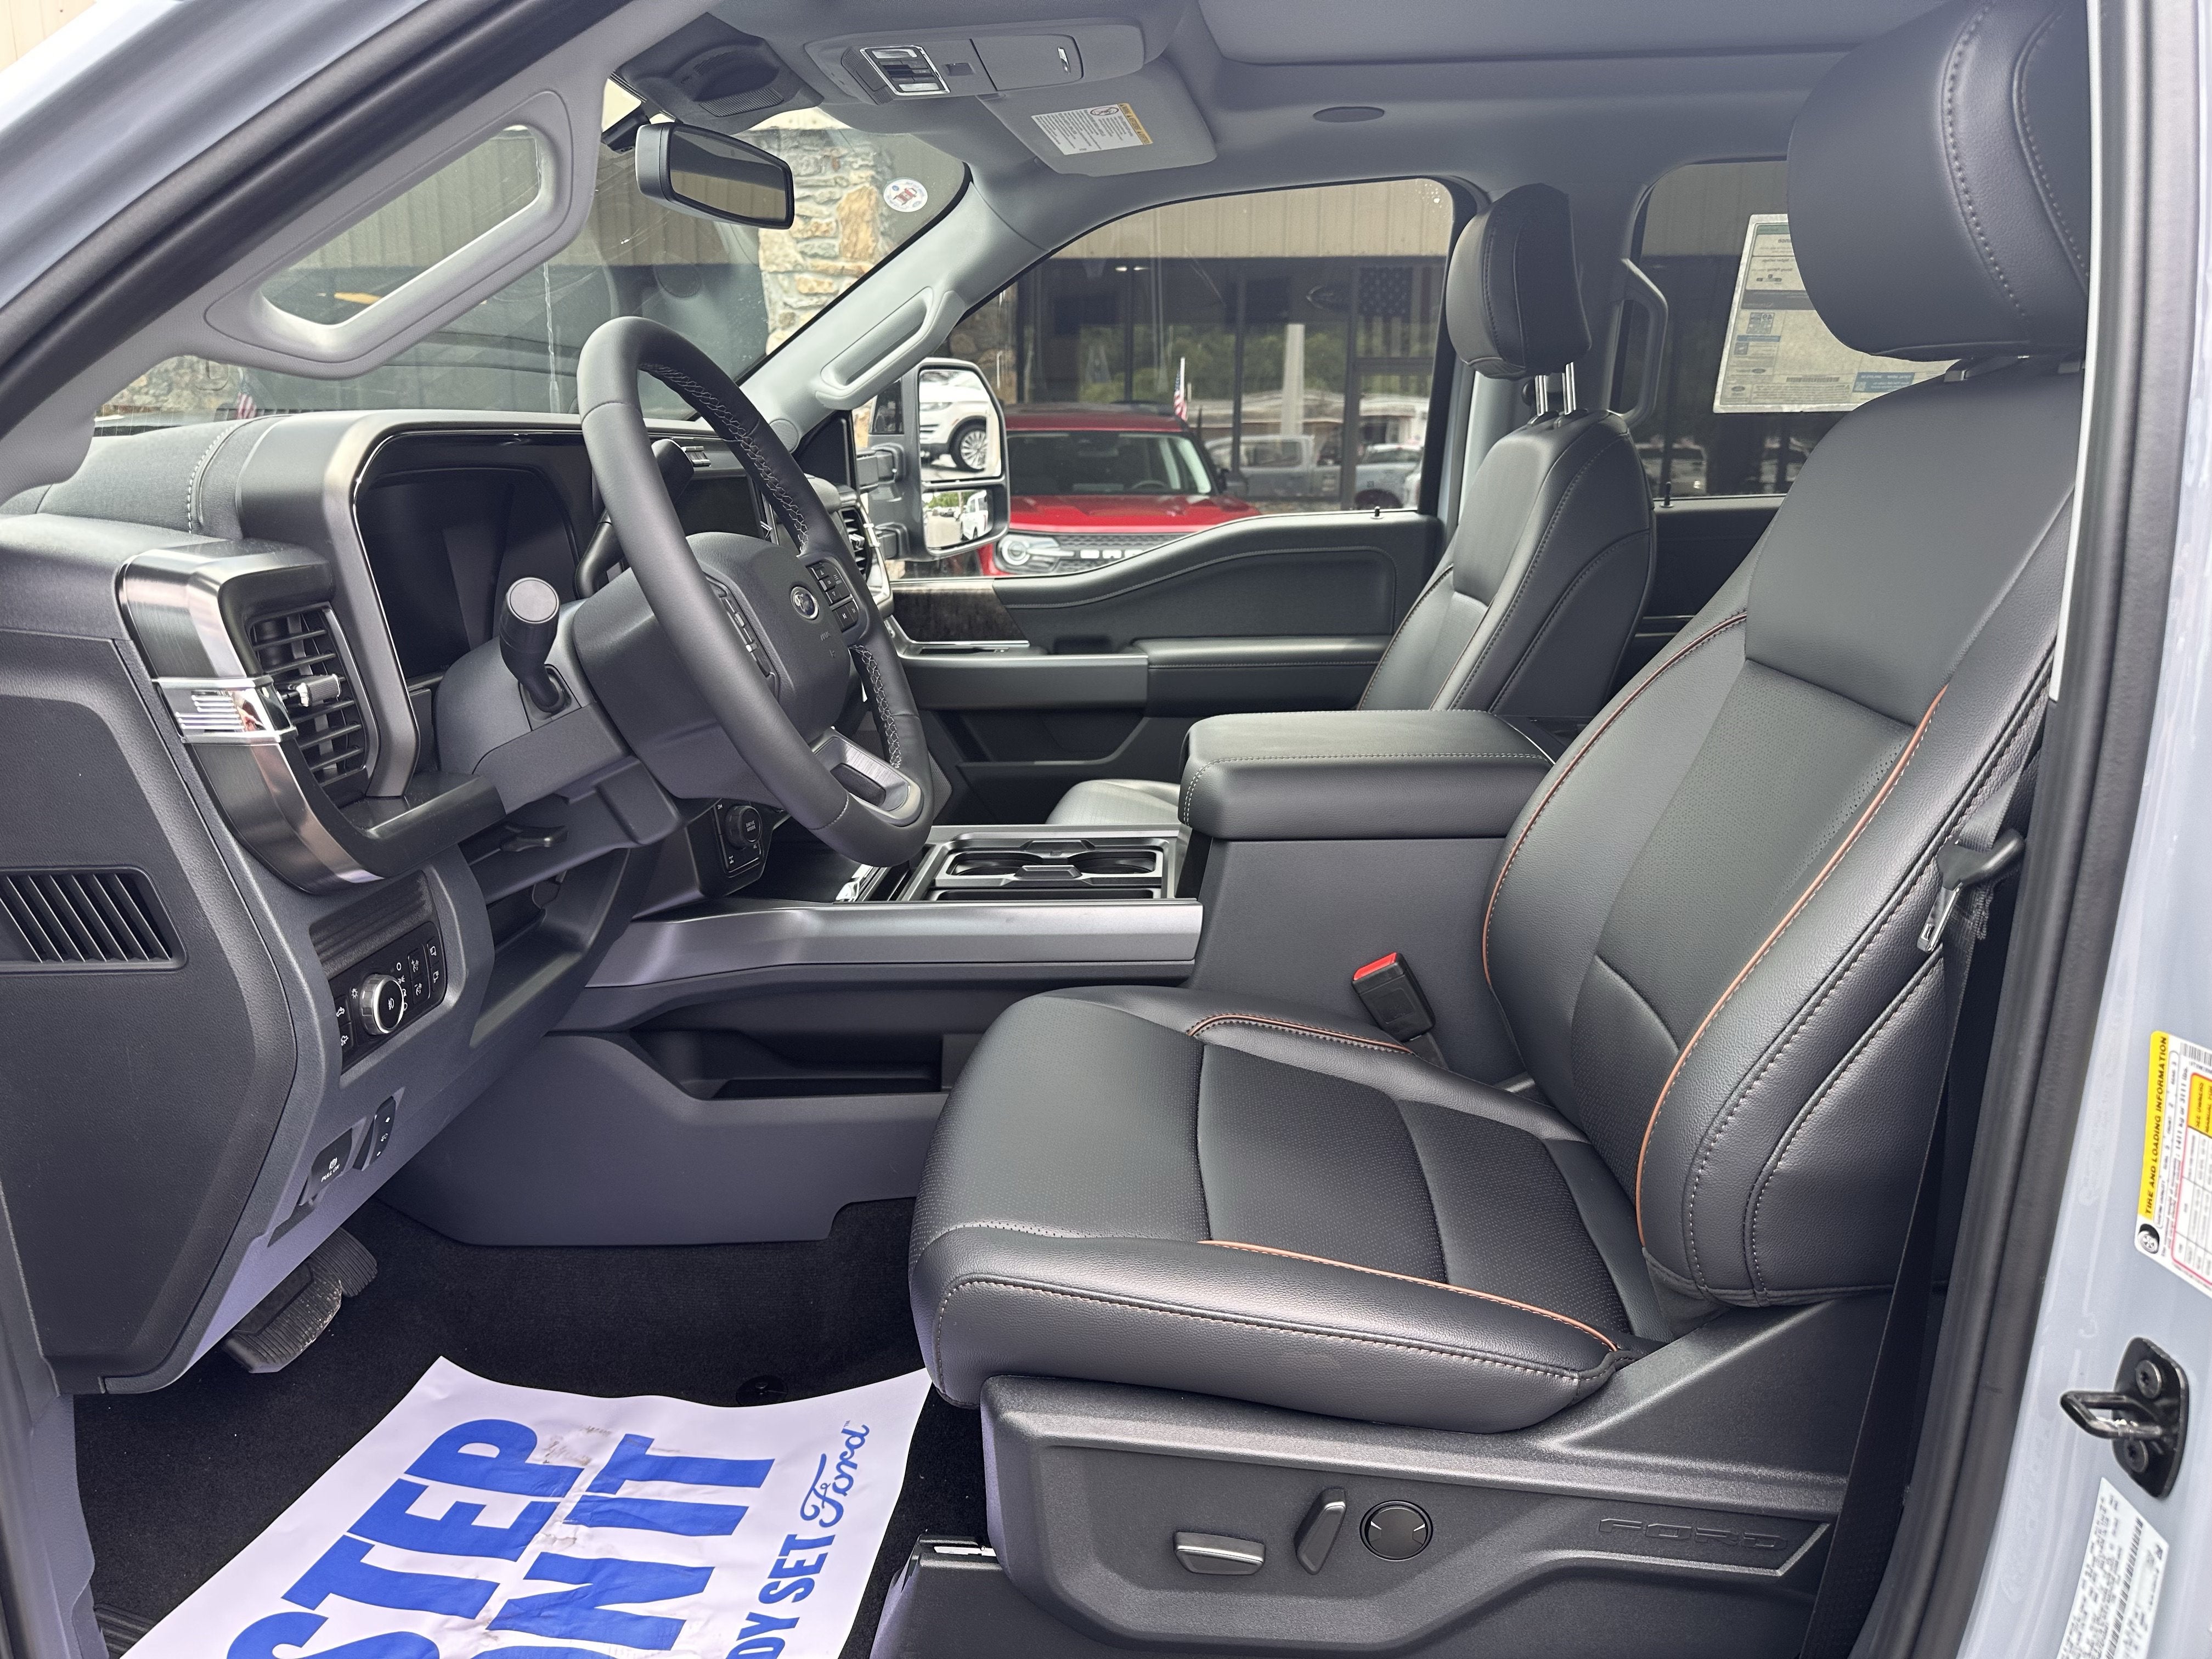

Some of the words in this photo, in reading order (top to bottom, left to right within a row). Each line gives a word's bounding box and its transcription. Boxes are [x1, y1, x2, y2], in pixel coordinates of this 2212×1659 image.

[2155, 1036, 2167, 1112] INFORMATION
[2177, 1117, 2185, 1128] kg
[2180, 1107, 2185, 1115] or
[2151, 1115, 2161, 1163] LOADING
[333, 1164, 340, 1172] ON
[2145, 1190, 2153, 1214] TIRE
[563, 1434, 775, 1536] IT
[758, 1534, 835, 1604] SET
[800, 1425, 870, 1528] Ford
[1599, 1519, 1787, 1550] FORD
[227, 1419, 585, 1659] STEP
[470, 1552, 715, 1659] N
